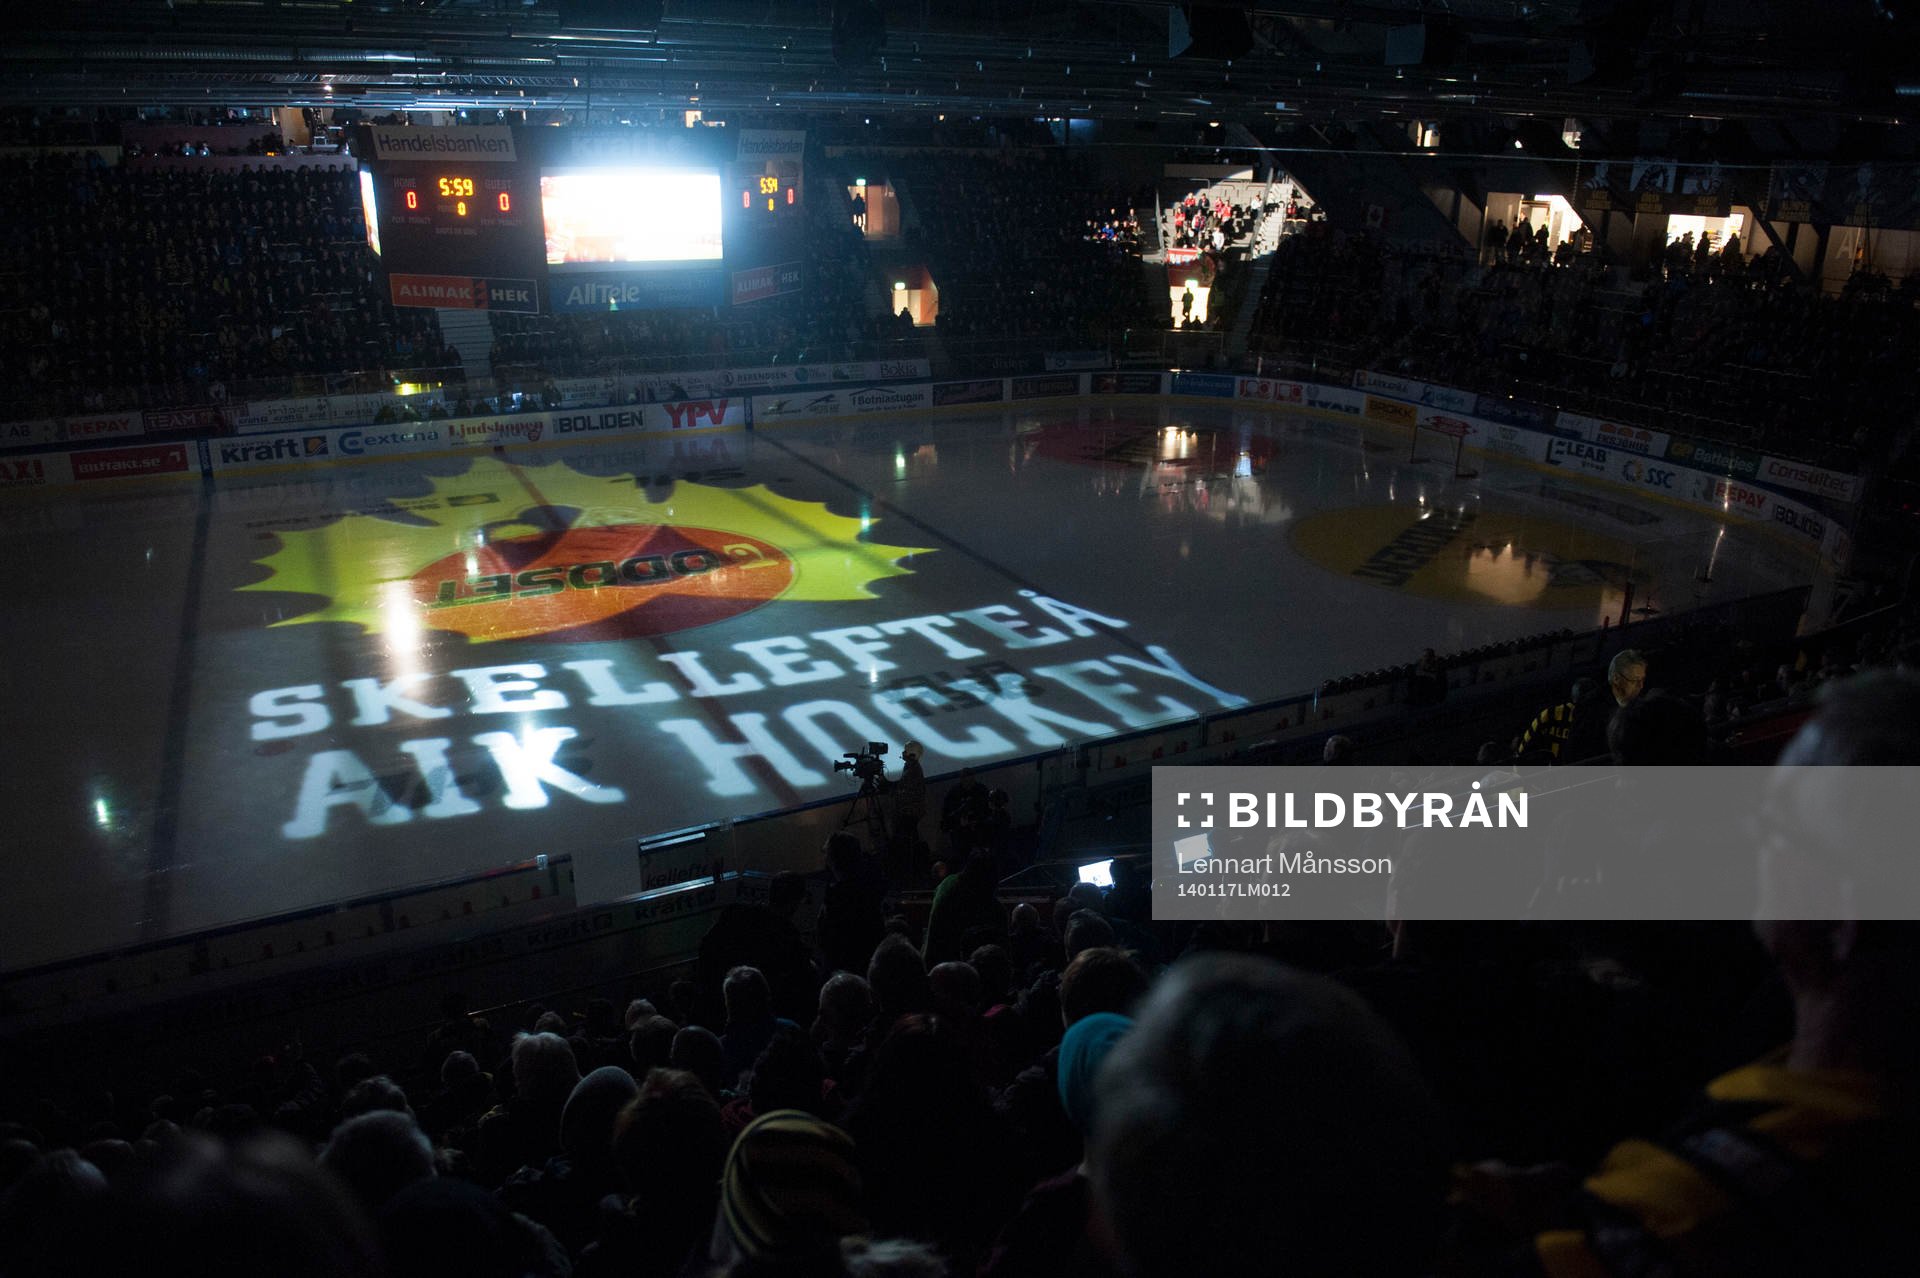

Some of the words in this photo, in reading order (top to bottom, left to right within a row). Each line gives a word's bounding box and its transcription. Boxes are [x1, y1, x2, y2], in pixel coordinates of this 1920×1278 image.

[376, 134, 511, 154] Handelsbanken
[439, 177, 474, 196] 5:59
[407, 191, 417, 209] 0
[457, 201, 466, 216] 0
[499, 192, 510, 211] 0
[399, 283, 472, 300] ALIMAK
[490, 286, 529, 303] HEK
[736, 273, 774, 294] ALIMAK
[780, 269, 800, 285] HEK
[565, 282, 641, 306] AllTele
[559, 410, 643, 433] BOLIDEN
[662, 399, 729, 429] YPV
[220, 438, 301, 463] kraft
[1643, 466, 1677, 489] SSC
[434, 548, 721, 608] ODDSET
[249, 588, 1131, 742] SKELLEFTEÅ
[281, 724, 627, 841] AIK
[657, 644, 1251, 797] HOCKEY
